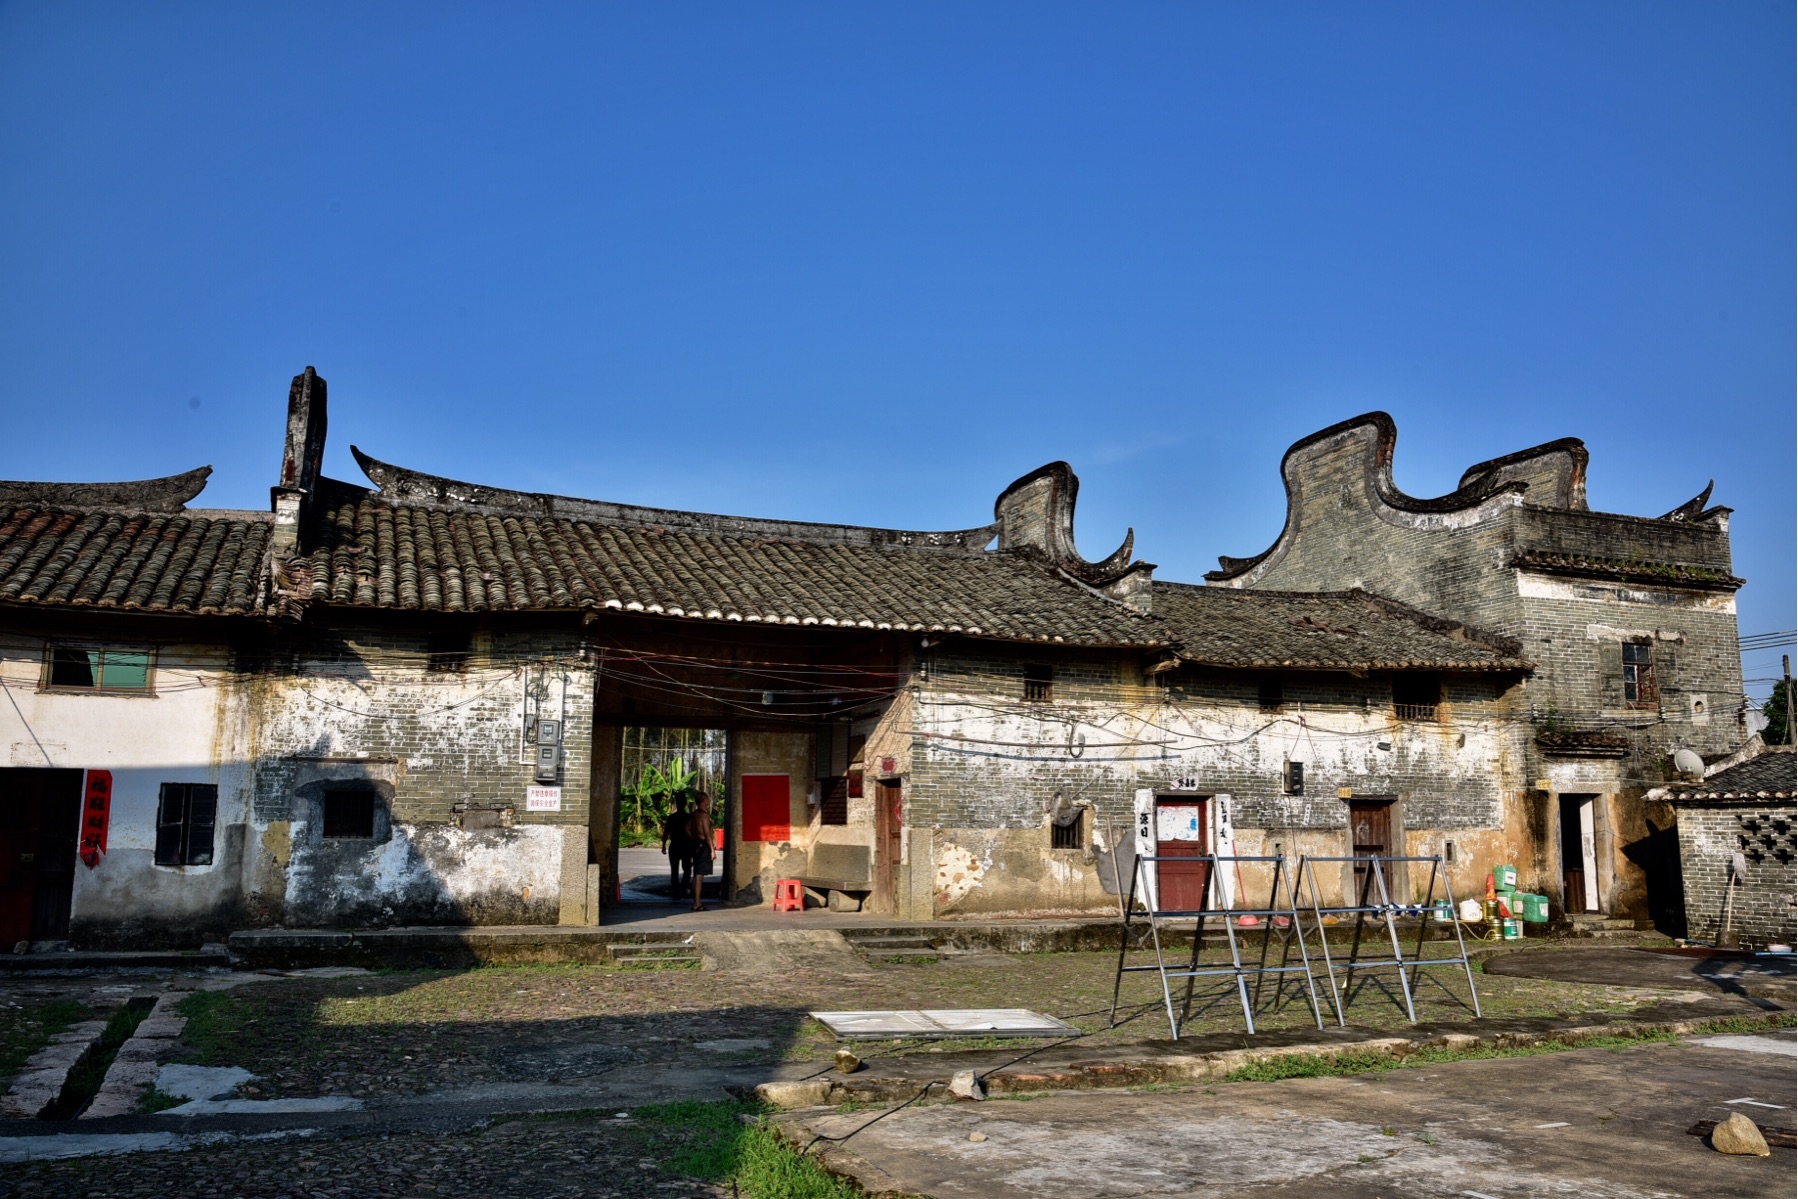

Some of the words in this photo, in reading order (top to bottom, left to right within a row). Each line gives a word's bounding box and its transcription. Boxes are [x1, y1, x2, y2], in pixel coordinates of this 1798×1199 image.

[531, 790, 558, 798] 严禁违章操作
